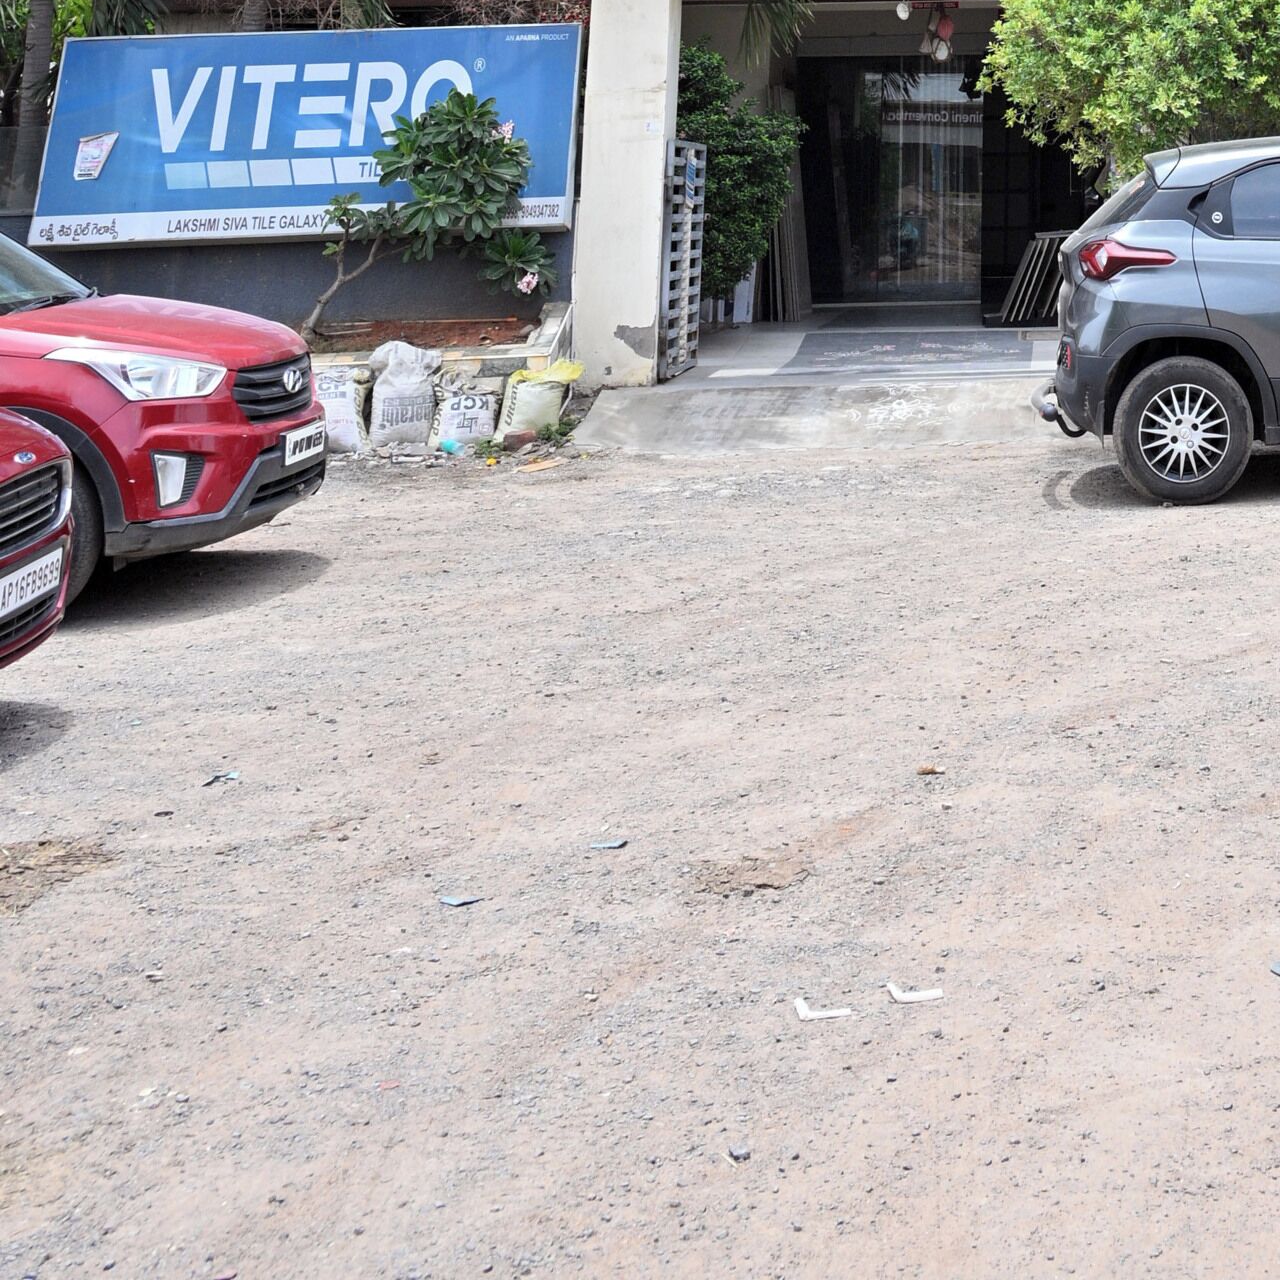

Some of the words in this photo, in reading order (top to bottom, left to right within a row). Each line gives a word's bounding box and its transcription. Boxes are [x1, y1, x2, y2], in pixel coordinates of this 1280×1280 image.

[167, 218, 219, 233] LAKSHMI
[222, 217, 248, 231] SIVA
[252, 216, 276, 230] TILE
[279, 214, 327, 229] GALAXY
[450, 396, 489, 412] KCP
